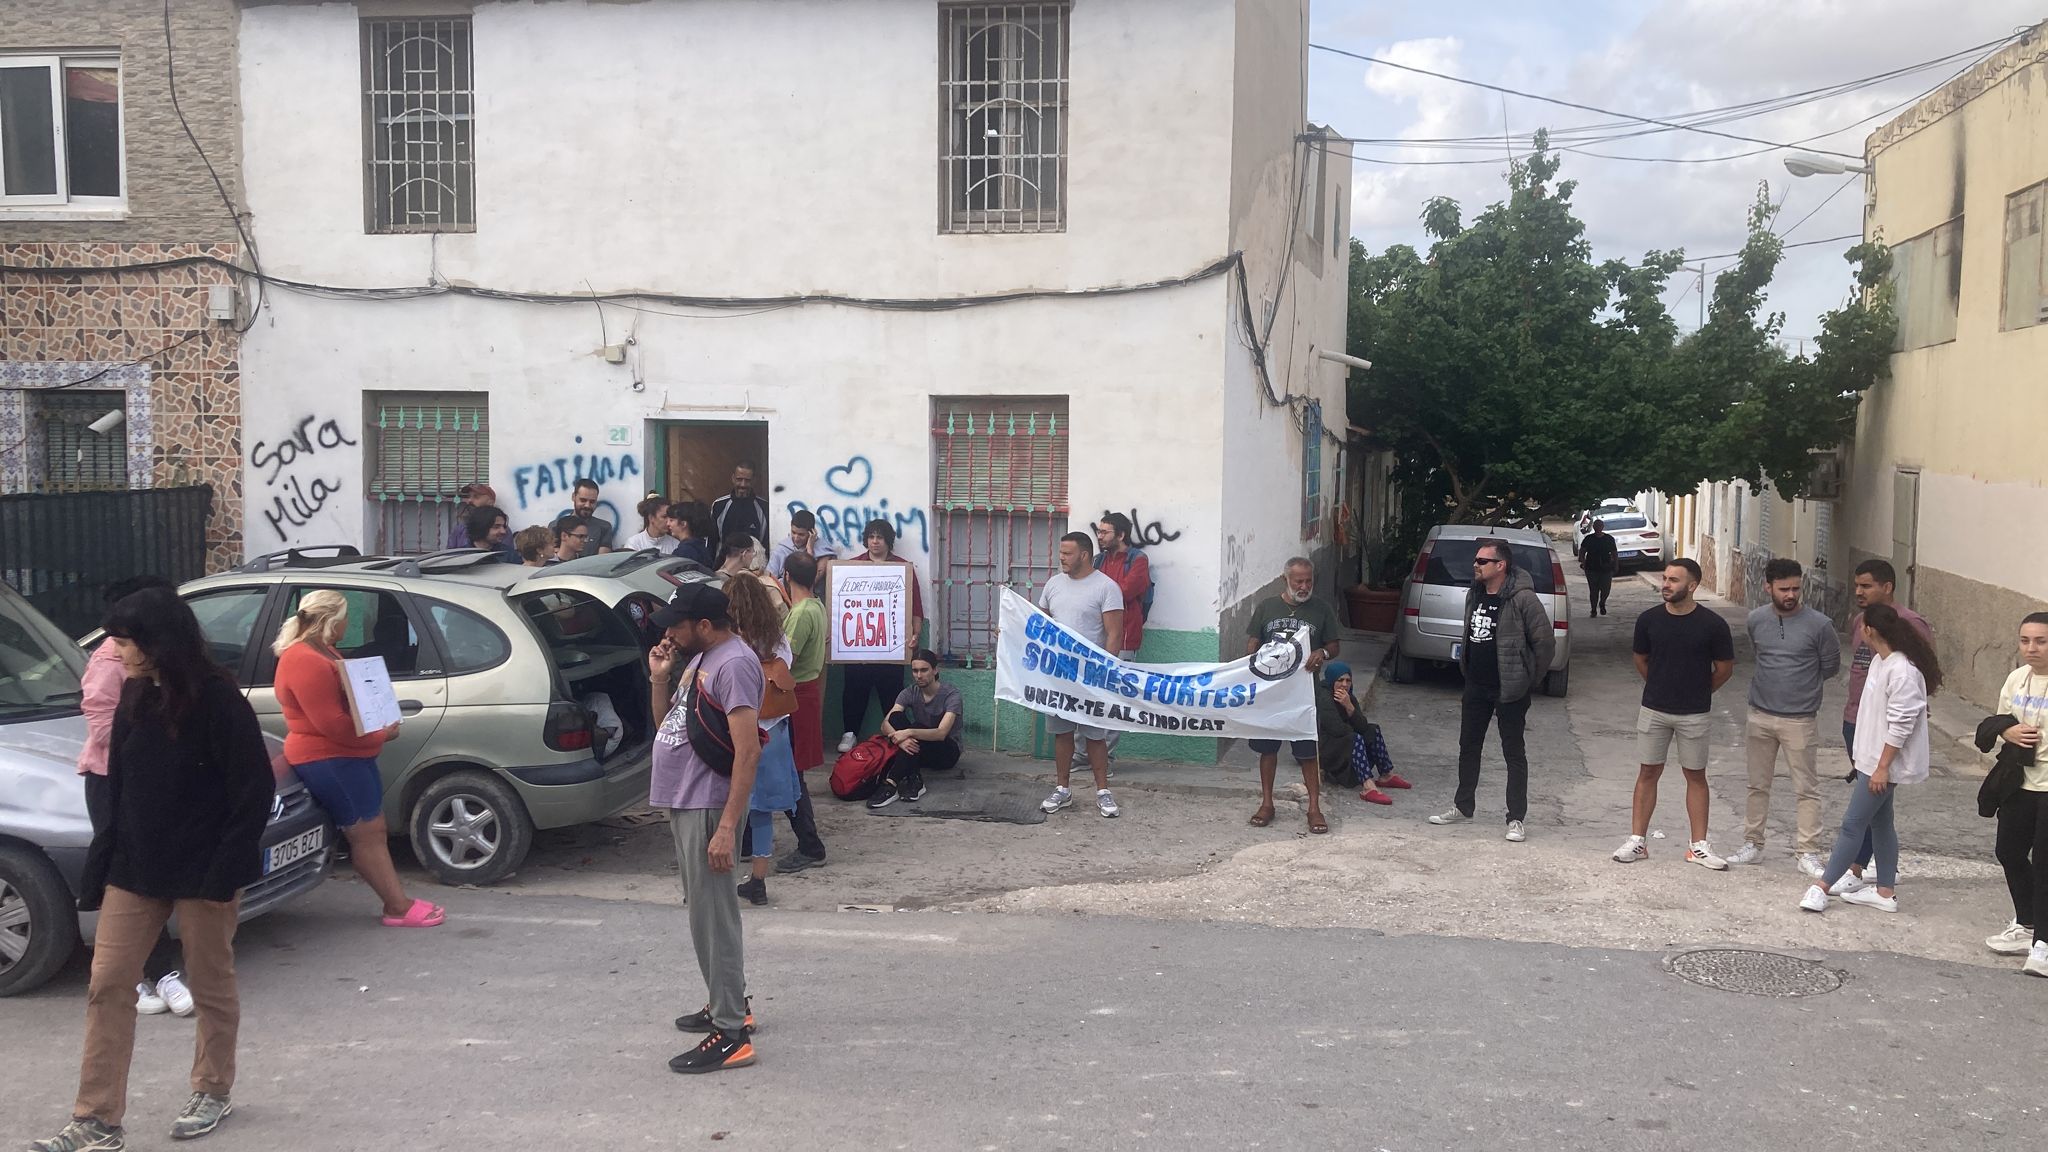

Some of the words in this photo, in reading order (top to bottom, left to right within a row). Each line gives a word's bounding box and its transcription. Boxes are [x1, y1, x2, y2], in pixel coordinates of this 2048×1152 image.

[251, 414, 357, 485] Sara
[264, 475, 341, 542] Mila
[841, 611, 887, 647] CASA
[1266, 617, 1318, 636] DETROT
[1022, 642, 1080, 683] SOM
[1024, 685, 1105, 718] UNEIX-TE
[1107, 704, 1136, 723] AL
[1137, 710, 1226, 731] SINDICAT
[273, 839, 299, 868] 3705
[301, 828, 321, 855] BZT
